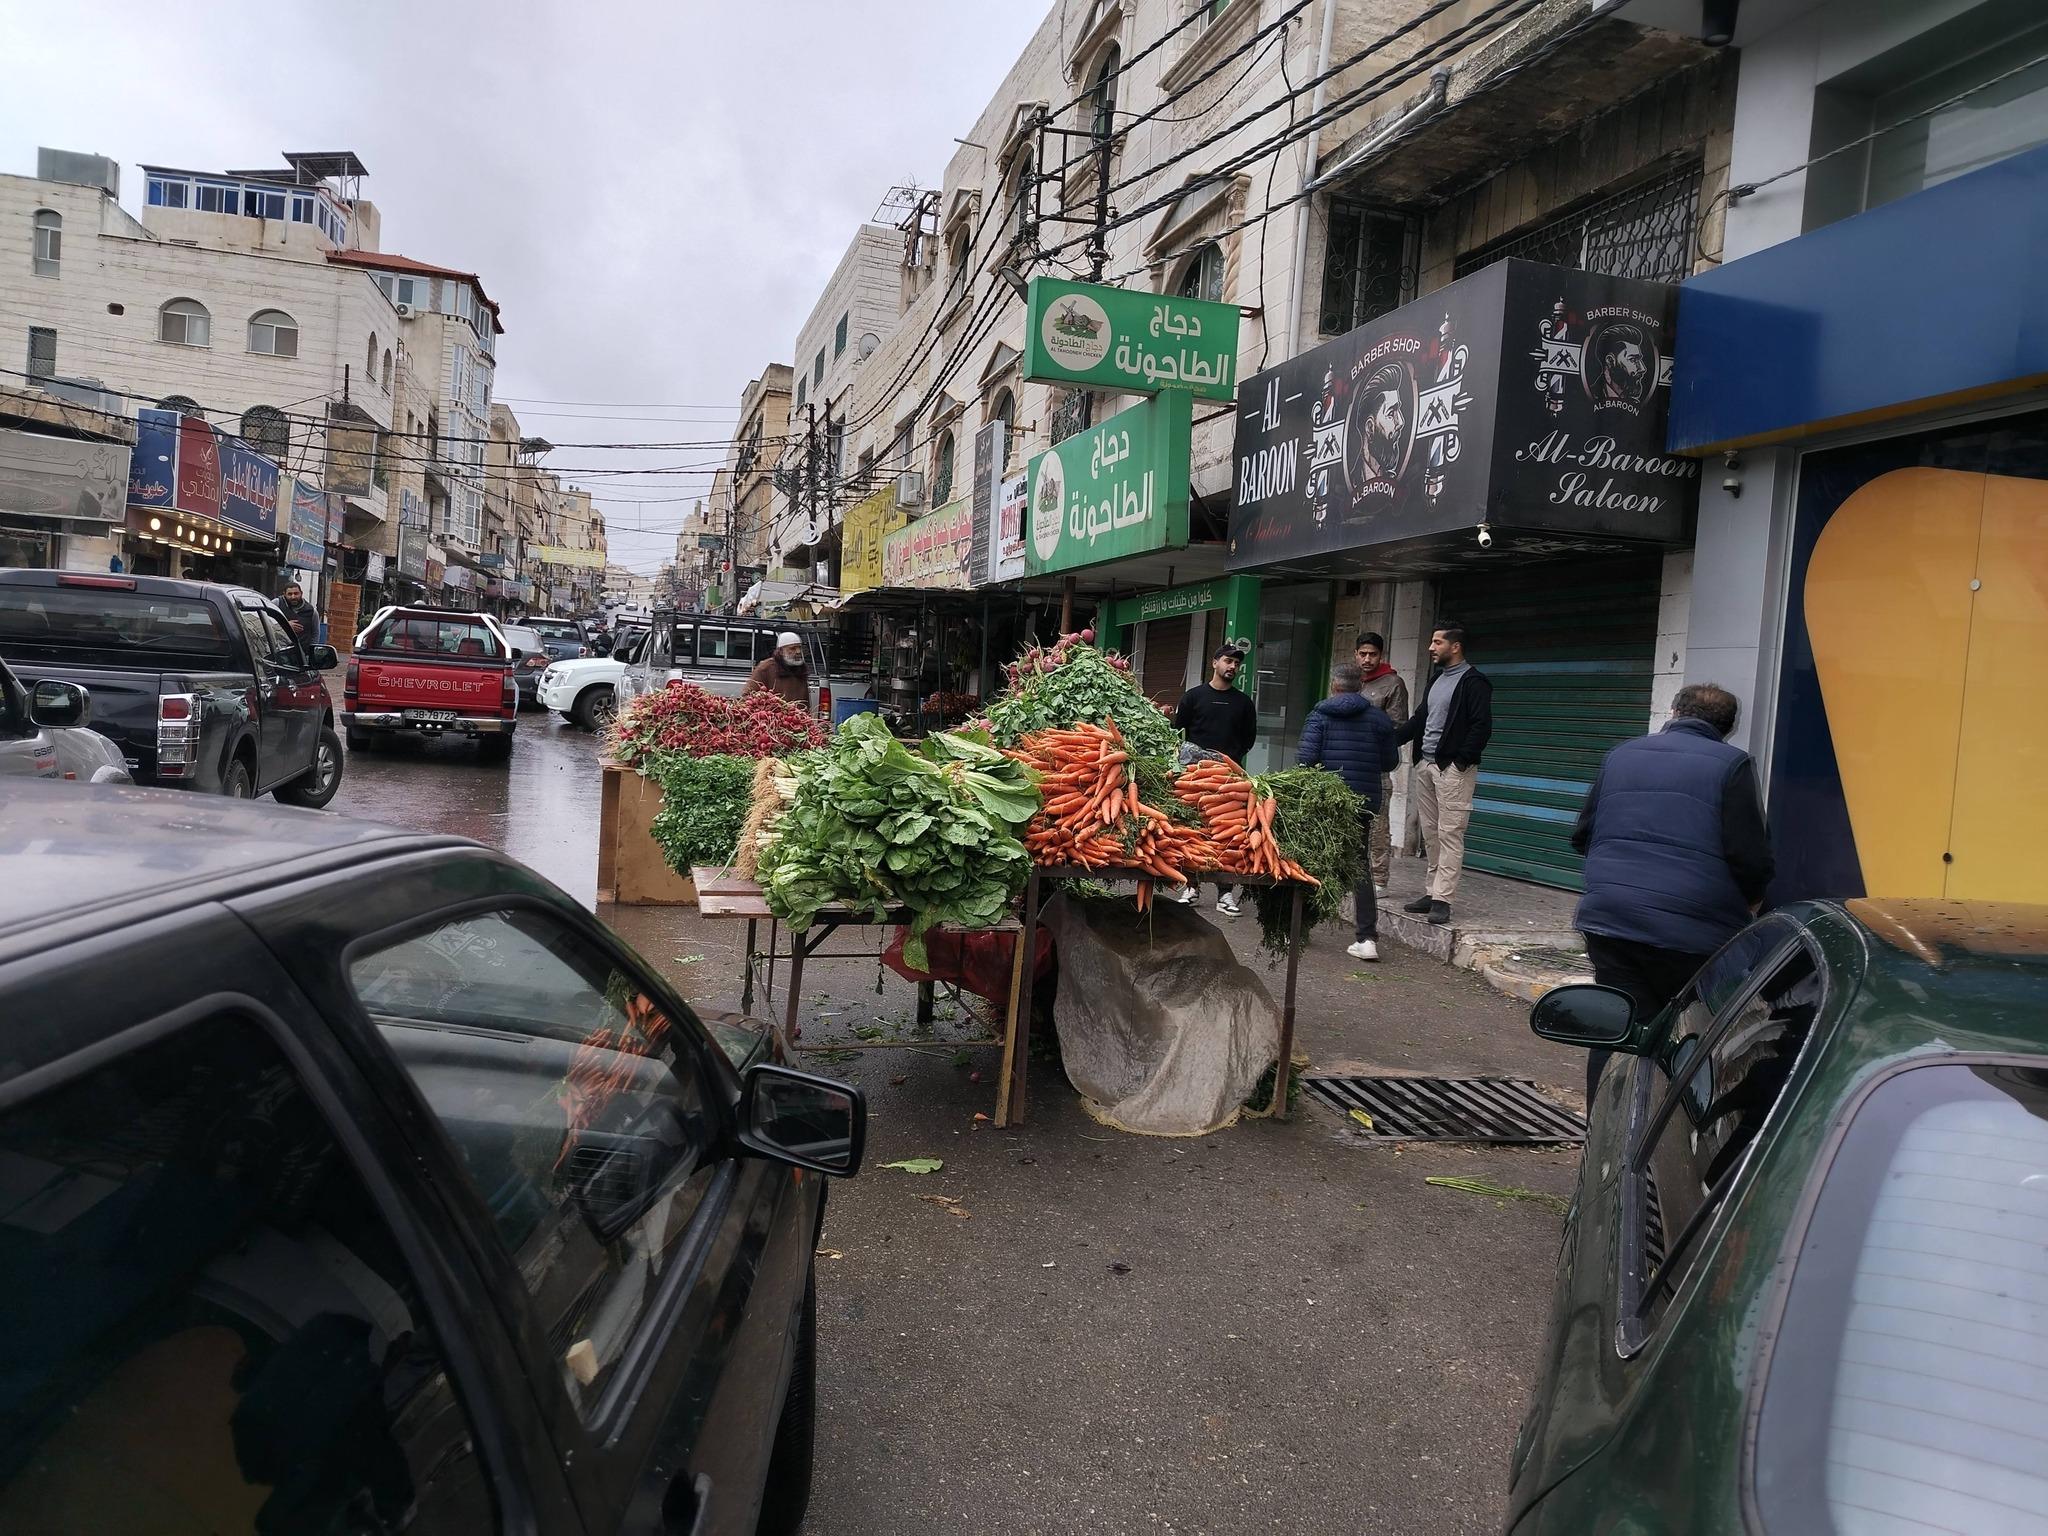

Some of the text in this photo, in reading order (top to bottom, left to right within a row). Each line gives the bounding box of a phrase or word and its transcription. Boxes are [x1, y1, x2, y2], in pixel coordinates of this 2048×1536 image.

[1150, 305, 1202, 341] دجاج
[1586, 306, 1660, 329] BARBER SHOP
[1050, 335, 1103, 352] دجاج الطاحونة
[1115, 335, 1229, 386] الطاحونة
[1351, 338, 1421, 381] BARBER SHOP
[1262, 376, 1281, 433] AL
[1593, 400, 1640, 417] AL-BAROON
[1091, 428, 1130, 480] دجاج
[1238, 437, 1300, 506] BAROON
[1515, 429, 1698, 479] Al-Baroon
[1069, 469, 1154, 547] الطاحونة
[1351, 480, 1396, 508] AL-BAROON
[1549, 471, 1668, 513] Saloon
[377, 676, 484, 693] CHEVROLET
